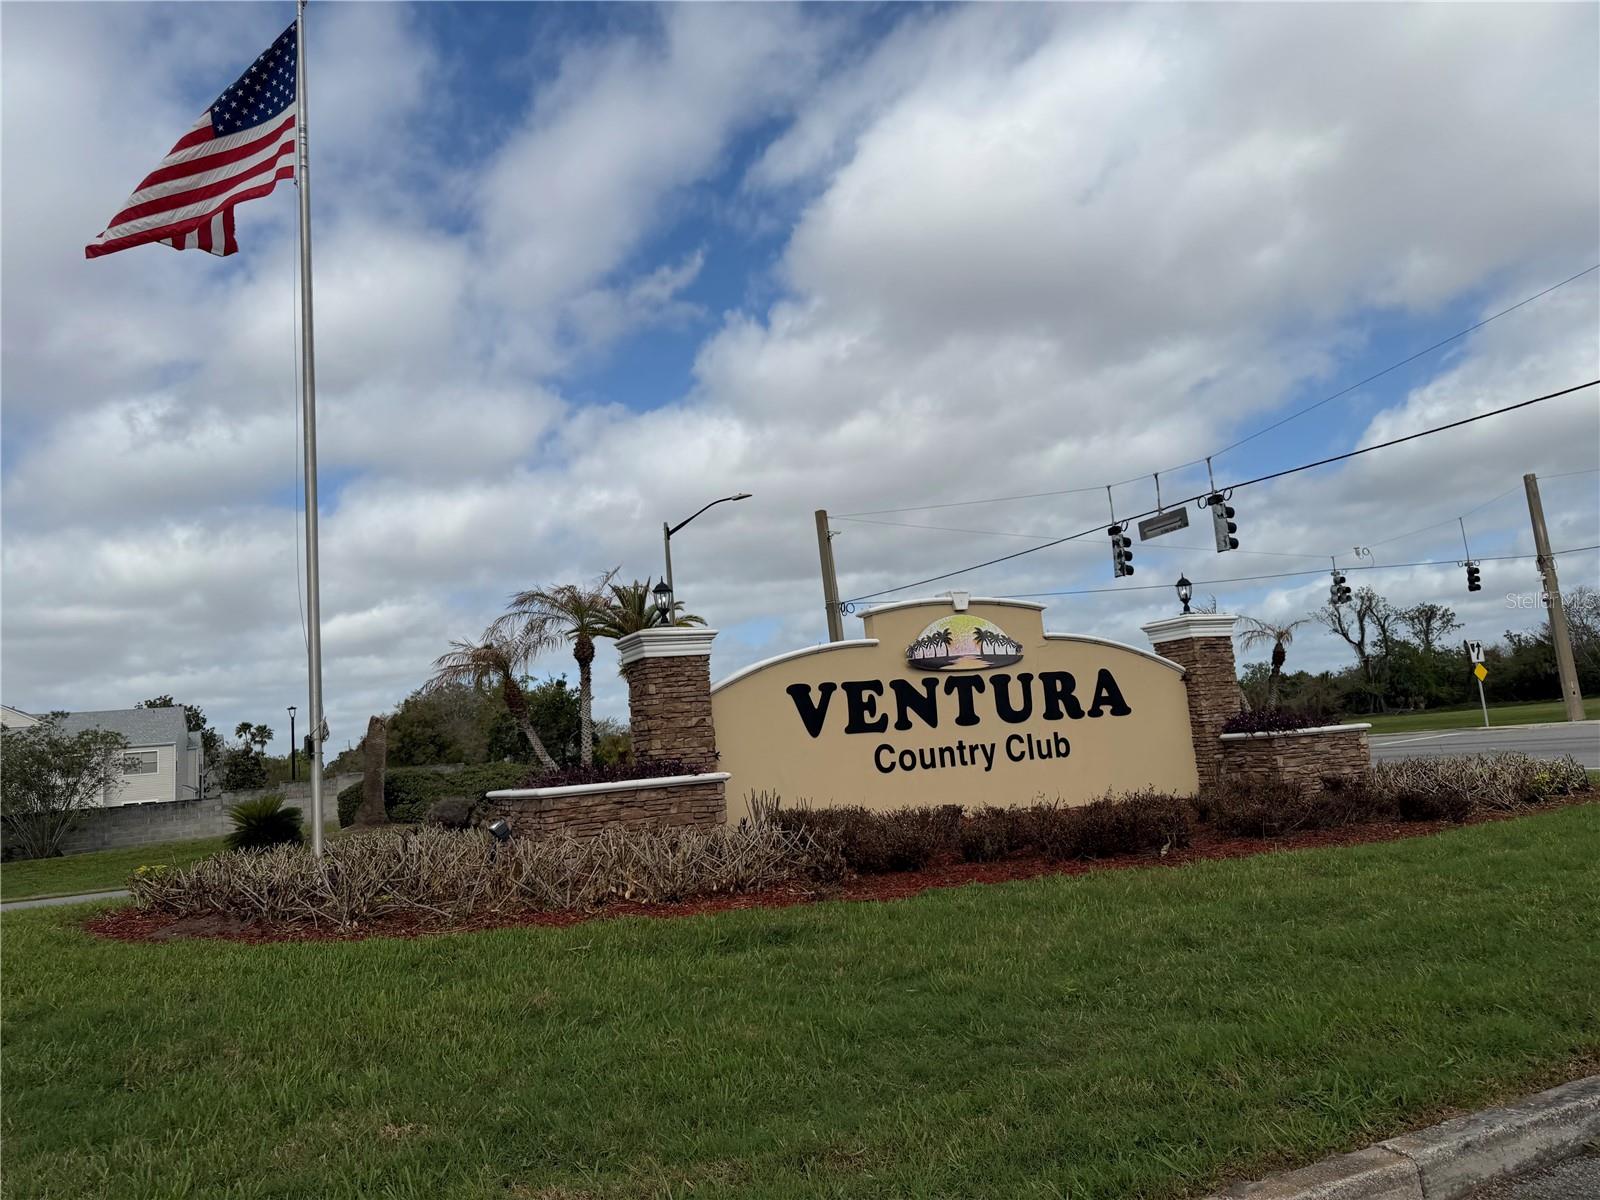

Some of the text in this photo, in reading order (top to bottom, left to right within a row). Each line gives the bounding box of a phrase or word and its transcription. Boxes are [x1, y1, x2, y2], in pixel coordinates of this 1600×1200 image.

[785, 668, 1132, 739] VENTURA
[874, 731, 1071, 774] Country Club
